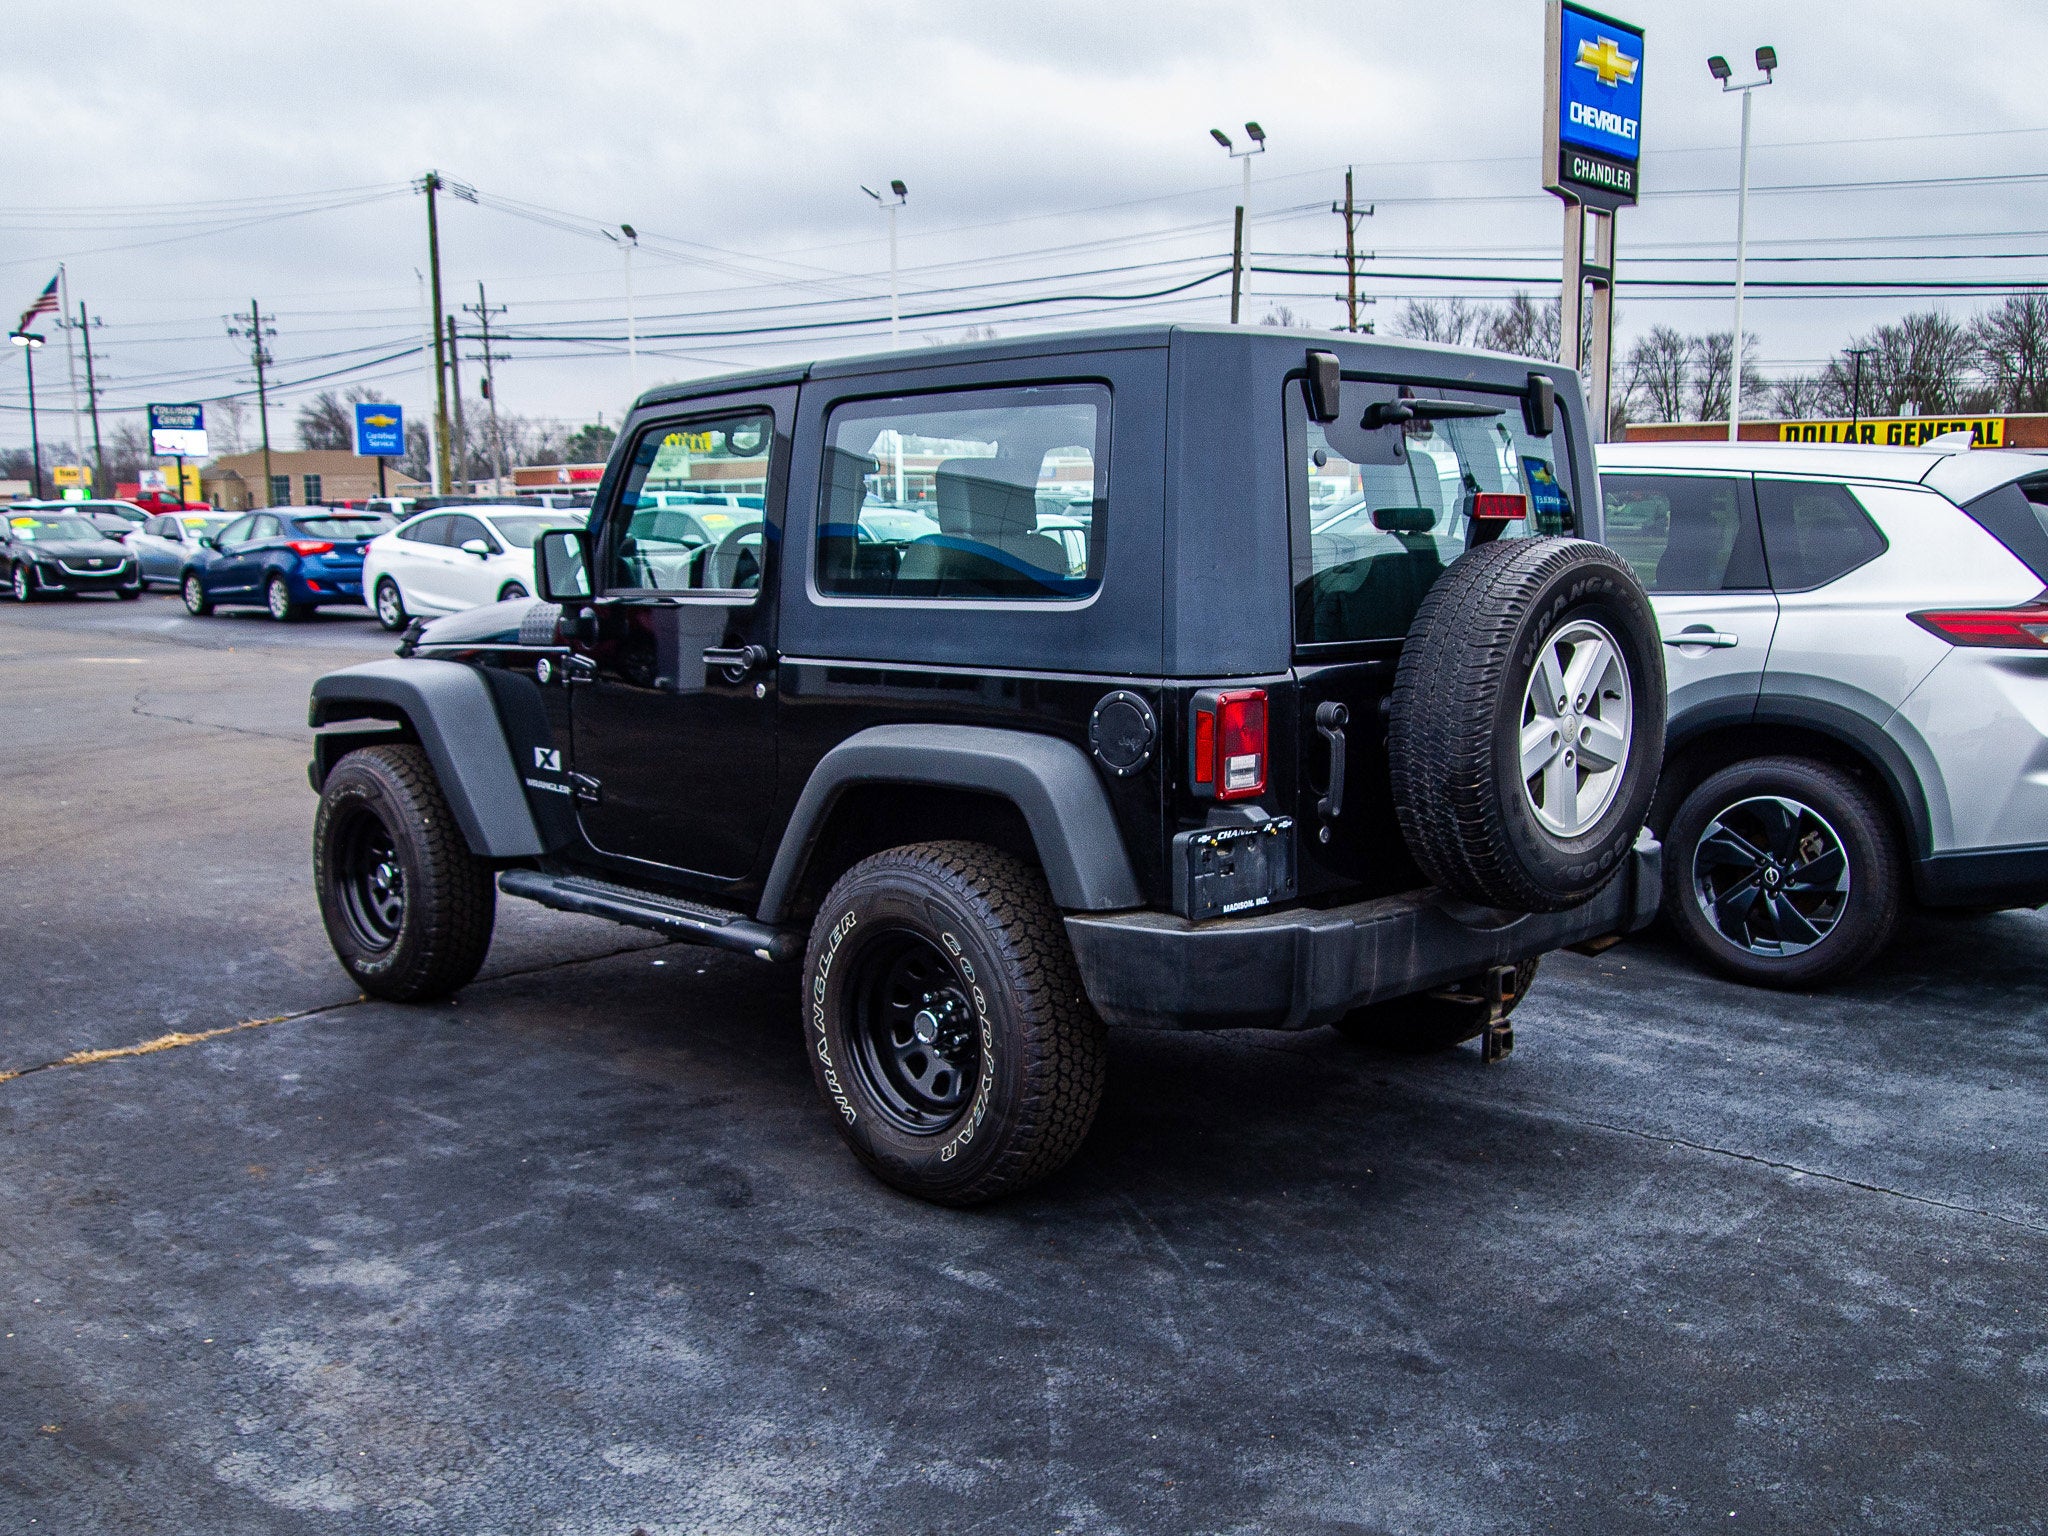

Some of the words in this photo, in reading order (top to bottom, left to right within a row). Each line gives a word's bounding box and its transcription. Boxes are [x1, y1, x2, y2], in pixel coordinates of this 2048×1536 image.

[1569, 101, 1639, 140] CHEVROLET
[1573, 157, 1632, 190] CHANDLER
[1785, 422, 1877, 444] DOLLAR
[536, 747, 559, 771] X
[811, 909, 858, 1126] WRANGLER
[940, 930, 995, 1163] GOODYEAR
